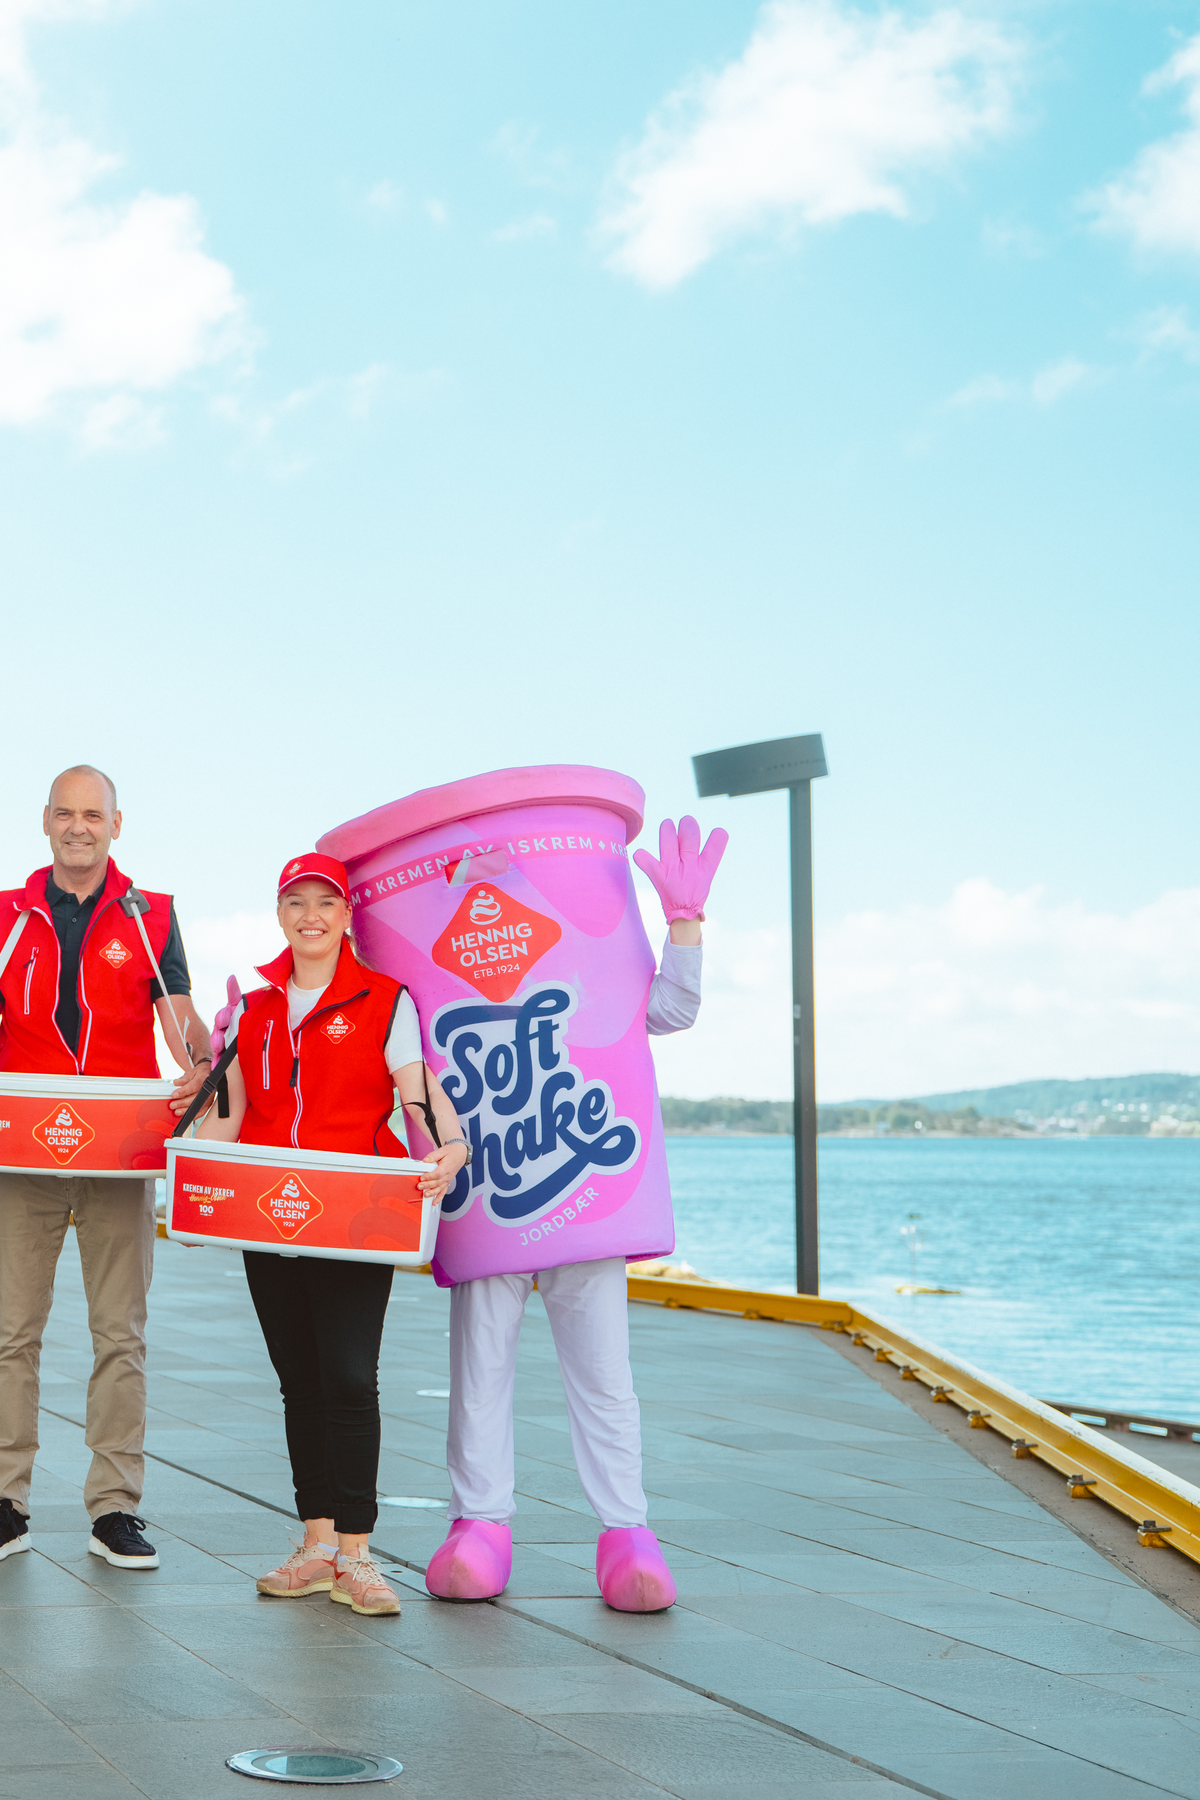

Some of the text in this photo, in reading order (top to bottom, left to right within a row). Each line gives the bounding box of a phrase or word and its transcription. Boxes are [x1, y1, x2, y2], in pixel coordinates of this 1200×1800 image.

[376, 855, 450, 894] KREMEN
[507, 836, 593, 855] ISKREM
[451, 922, 533, 952] HENNIG
[460, 941, 528, 967] OLSEN
[473, 963, 520, 979] ETB.1924
[434, 988, 571, 1116] Soft
[44, 1127, 83, 1137] HENNIG
[47, 1136, 79, 1146] OLSEN
[198, 1204, 214, 1214] 100
[270, 1198, 310, 1210] HENNIG
[272, 1208, 306, 1220] OLSEN
[518, 1186, 600, 1247] JORDBÆR
